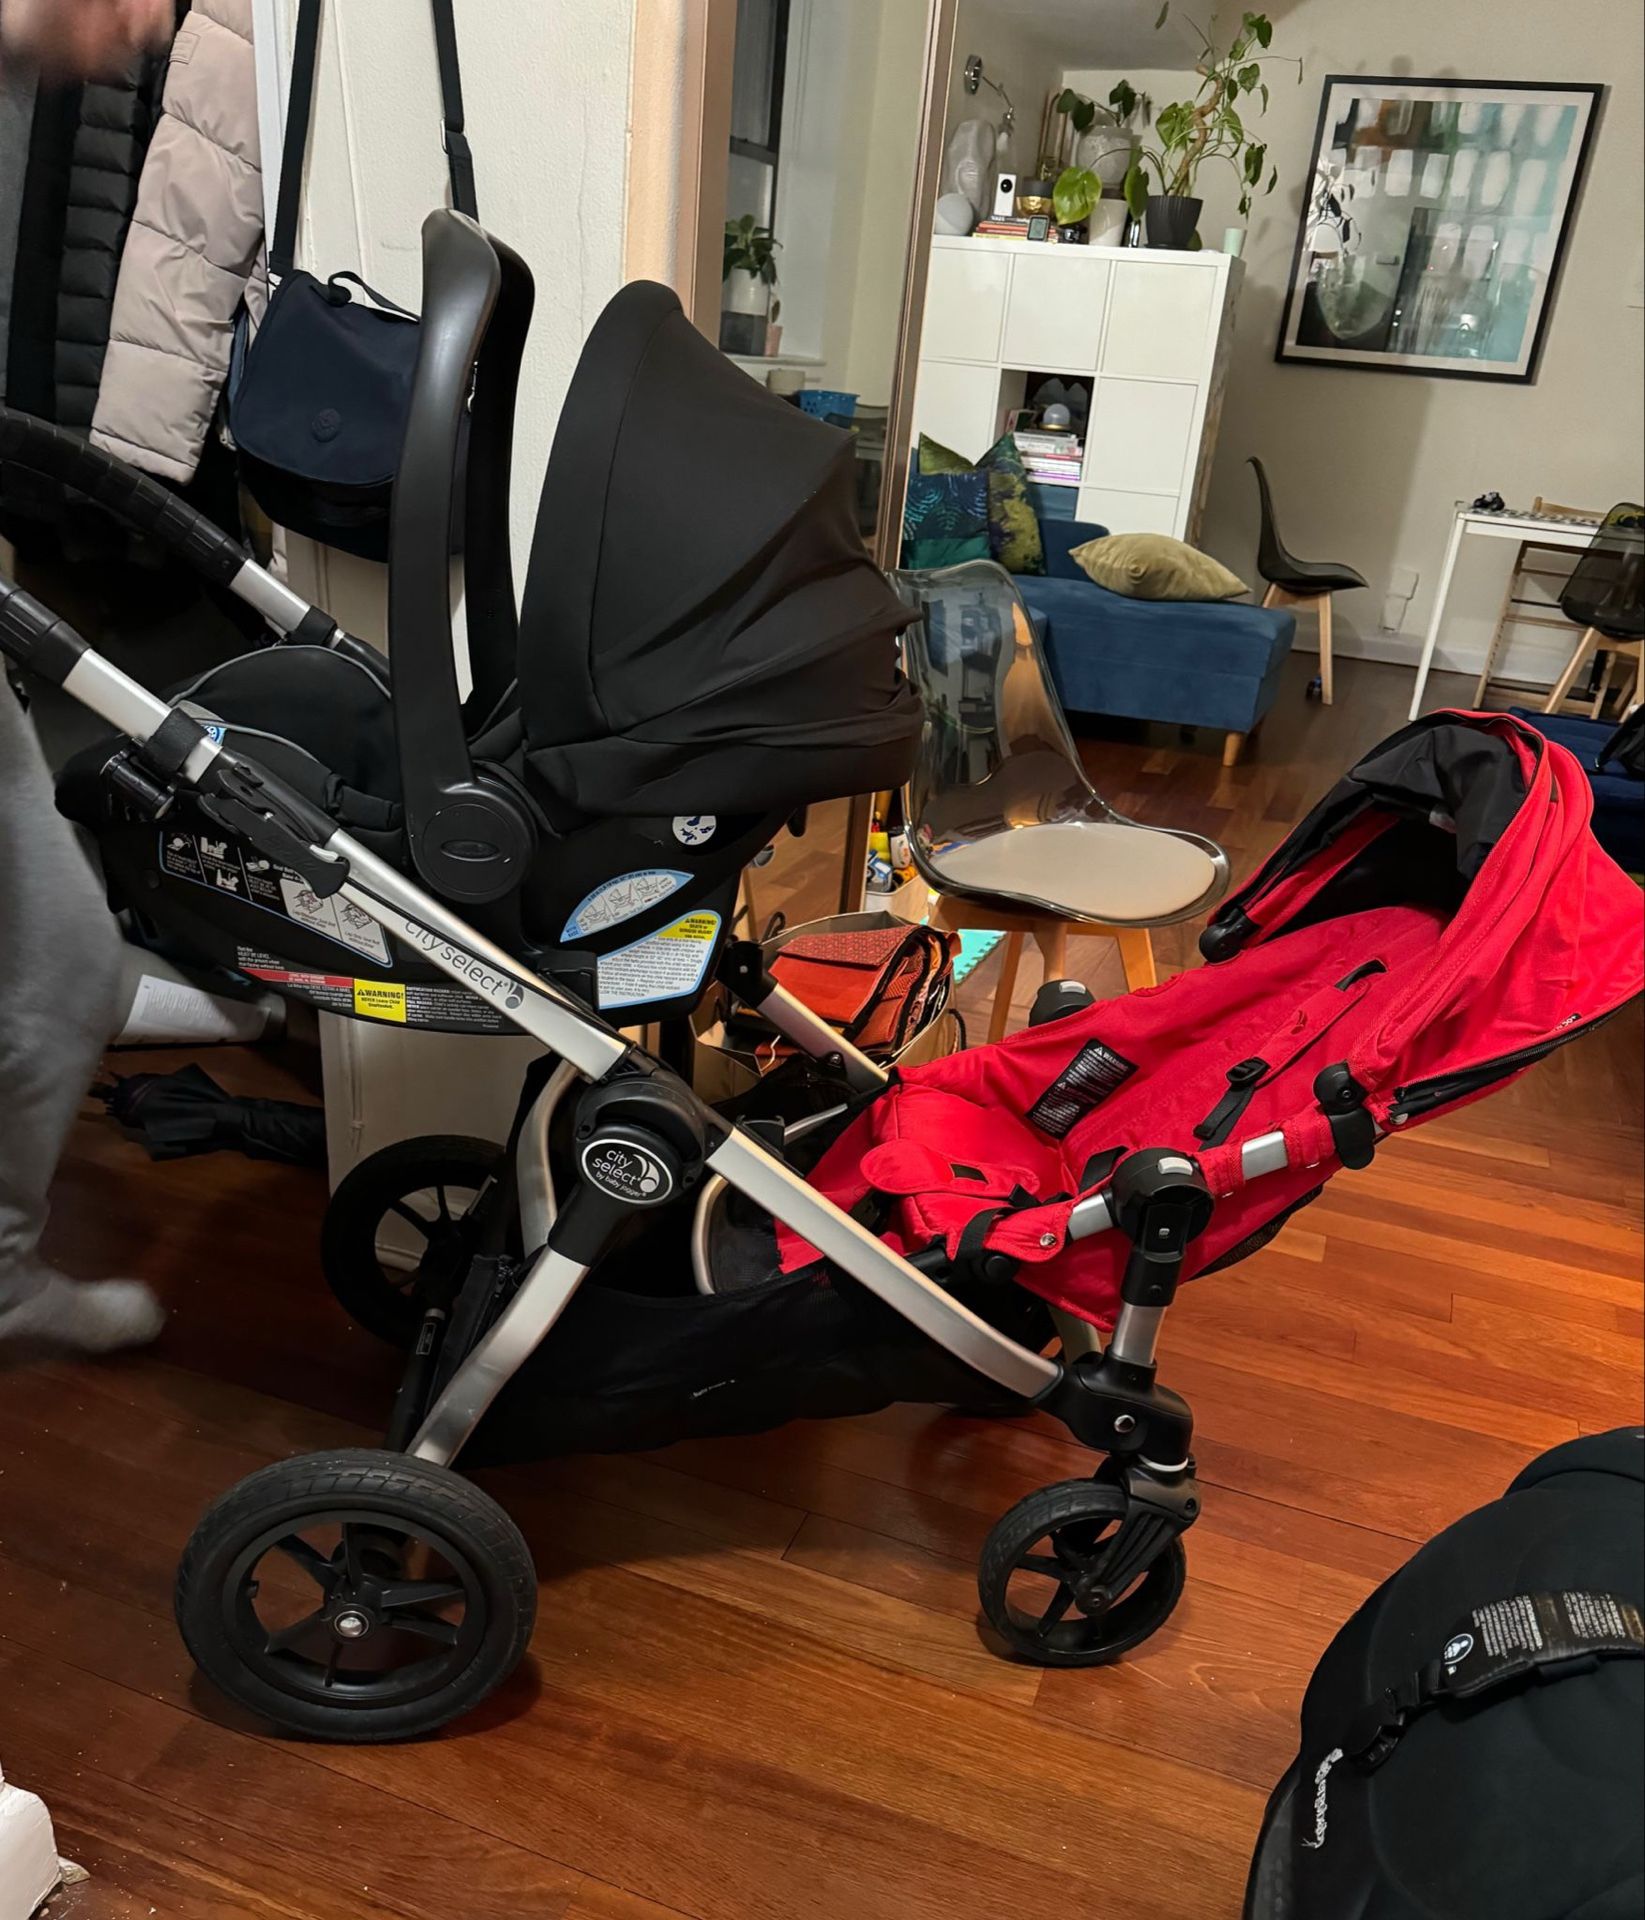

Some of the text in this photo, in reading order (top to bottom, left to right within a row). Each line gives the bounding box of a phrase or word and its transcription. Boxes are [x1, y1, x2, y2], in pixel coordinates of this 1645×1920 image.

[440, 945, 503, 996] select
[364, 989, 404, 1000] WARNING!
[606, 1150, 633, 1169] city
[592, 1157, 637, 1186] select
[596, 1170, 606, 1181] by
[604, 1175, 622, 1189] baby
